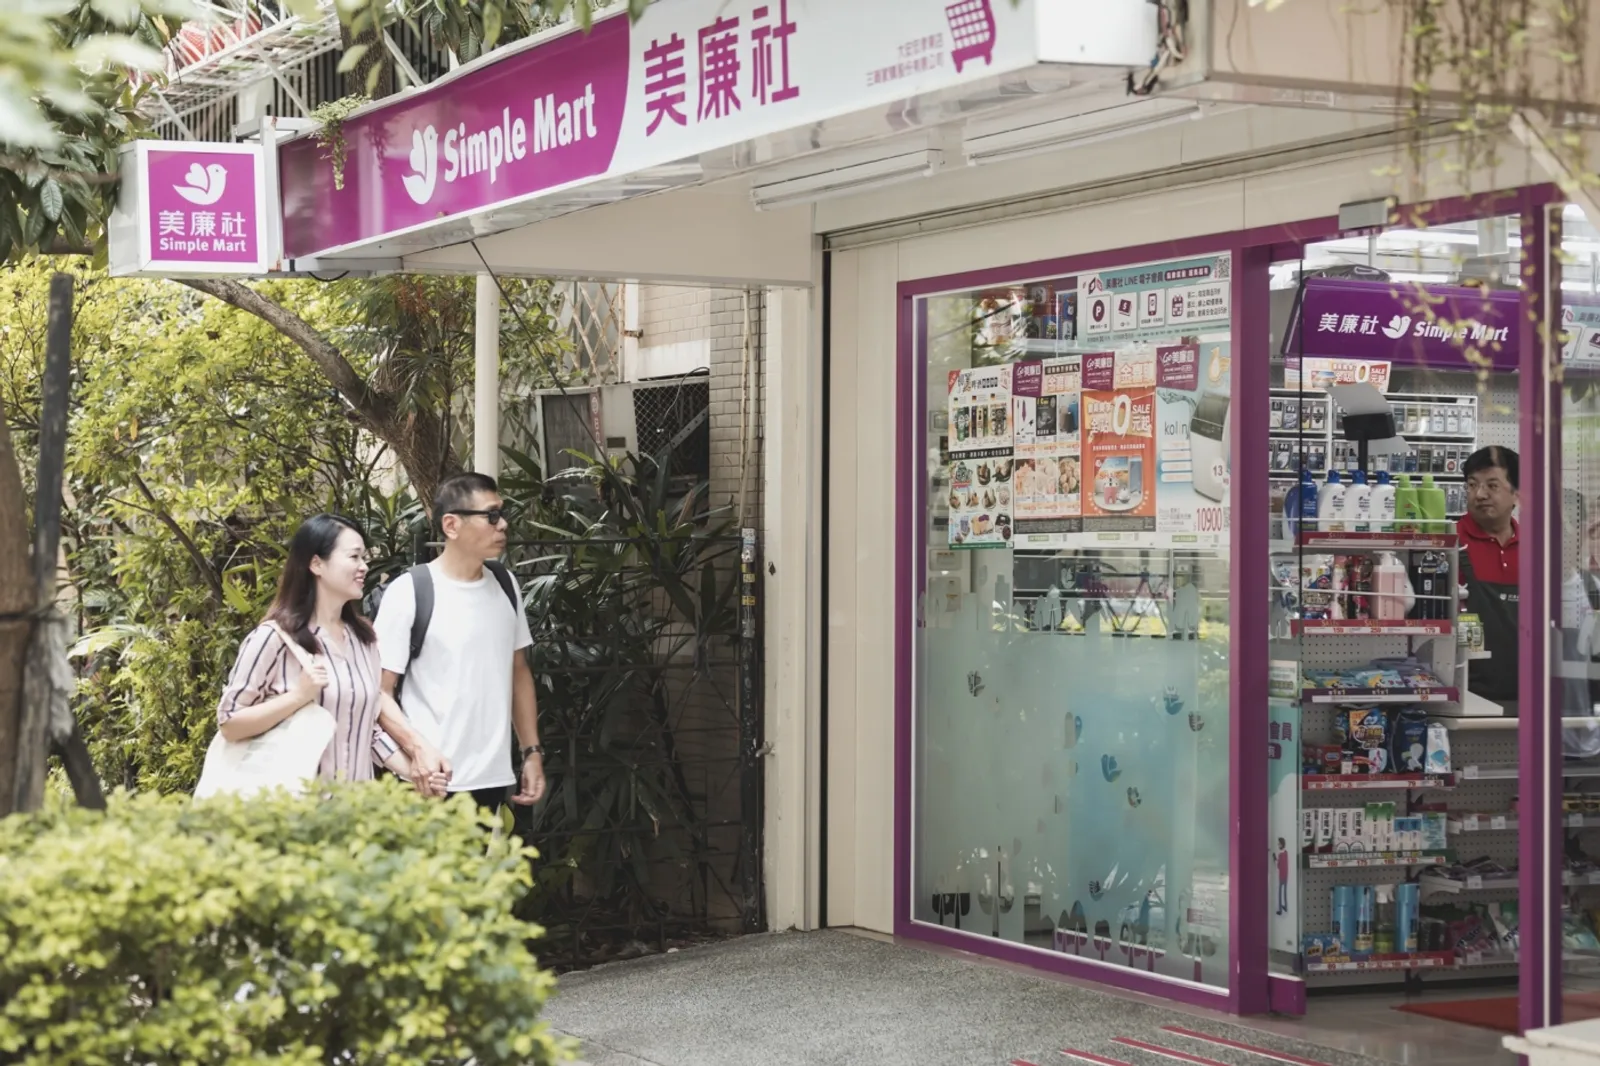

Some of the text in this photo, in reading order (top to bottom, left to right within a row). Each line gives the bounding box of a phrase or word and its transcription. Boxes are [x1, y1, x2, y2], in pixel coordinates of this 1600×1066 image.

[643, 0, 799, 137] 美廉社
[444, 83, 597, 184] Simple Mart
[158, 209, 246, 237] 美廉社
[159, 238, 246, 255] Simple Mart
[1125, 275, 1138, 286] LINE
[1317, 313, 1379, 335] 美廉社
[1132, 404, 1151, 414] SALE
[1164, 421, 1188, 436] kolin
[1213, 465, 1223, 476] 13
[1270, 721, 1292, 741] 會員
